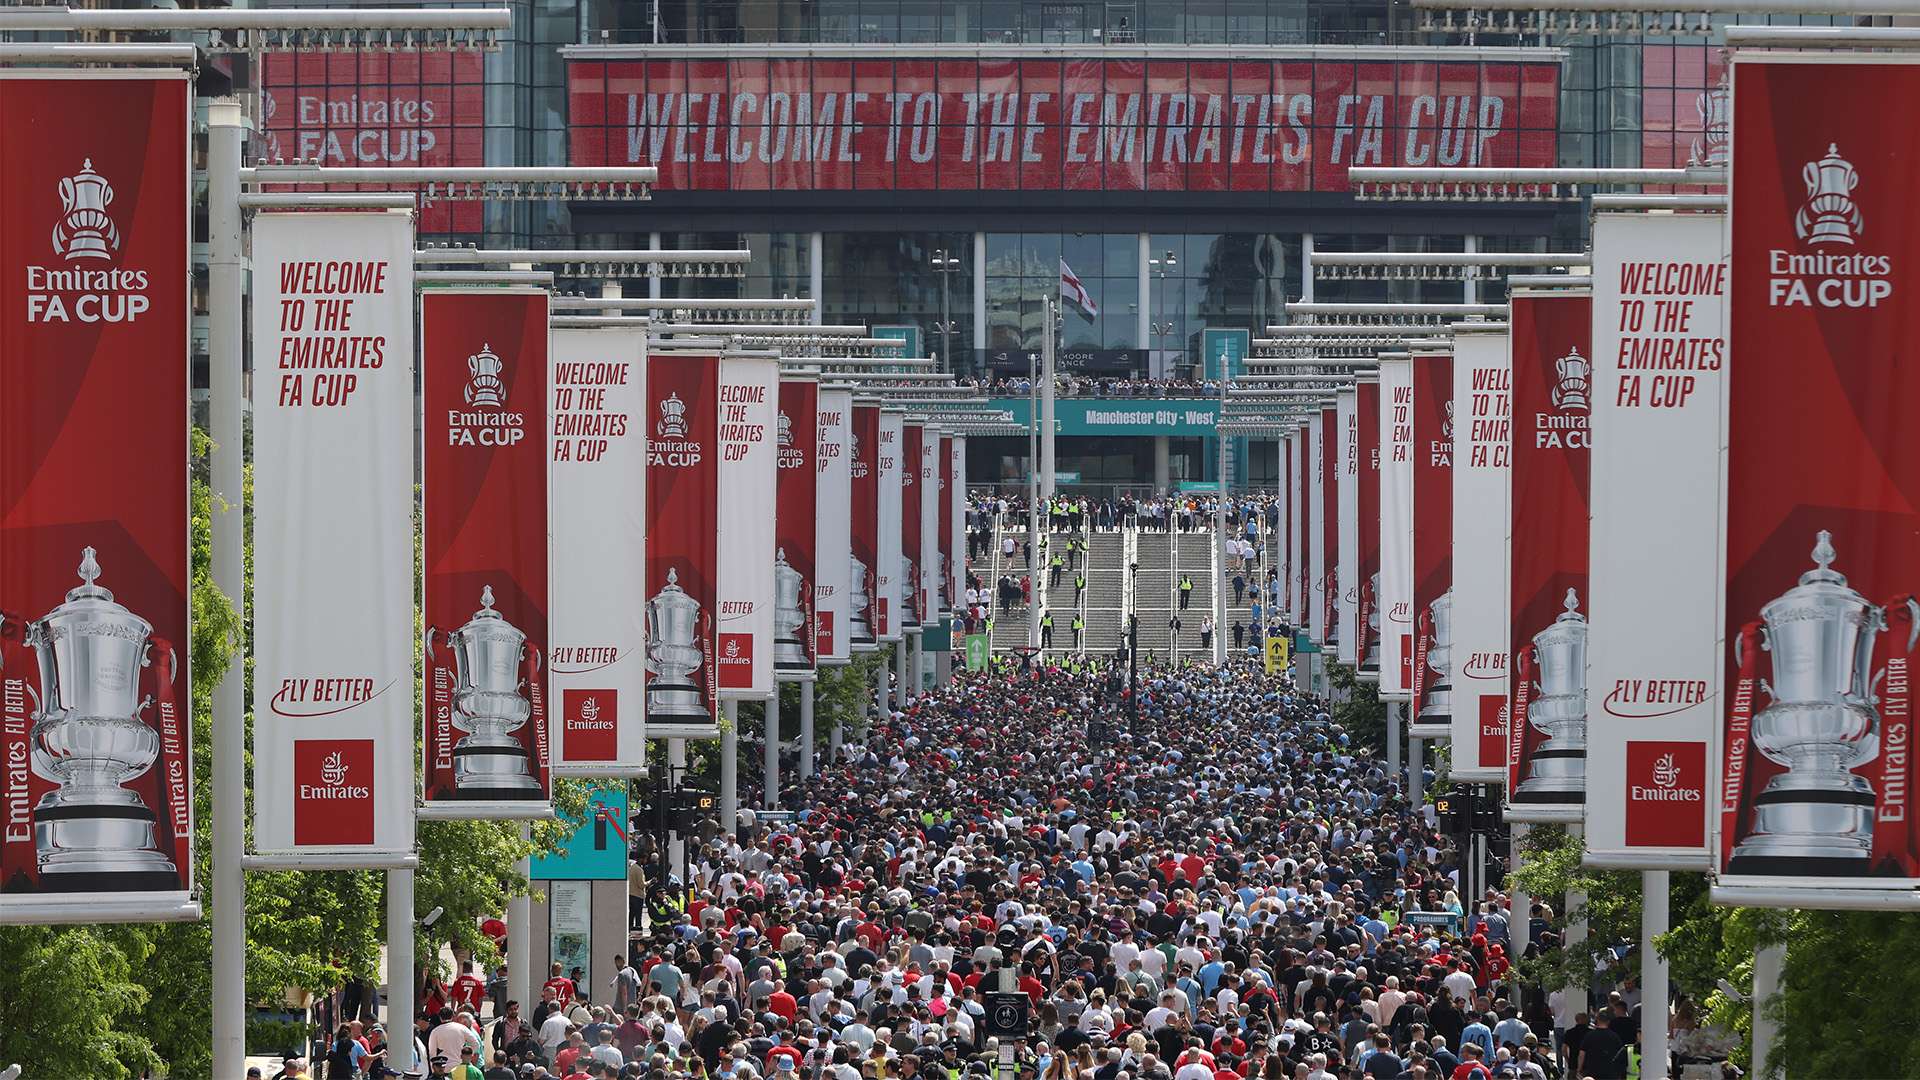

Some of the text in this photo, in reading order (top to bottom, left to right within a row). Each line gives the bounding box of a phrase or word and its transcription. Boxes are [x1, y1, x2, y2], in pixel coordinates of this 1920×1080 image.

[299, 94, 434, 124] Emirates
[627, 91, 1504, 166] WELCOME TO THE EMIRATES FA CUP
[300, 130, 436, 162] FA CUP
[1770, 250, 1890, 276] Emirates
[26, 265, 149, 291] Emirates
[279, 261, 388, 294] WELCOME
[1620, 262, 1726, 296] WELCOME
[1769, 279, 1892, 307] FA CUP
[27, 294, 150, 322] FA CUP
[279, 299, 352, 331] TO THE
[1619, 300, 1694, 333] TO THE
[278, 336, 386, 369] EMIRATES
[1617, 337, 1724, 371] EMIRATES
[555, 362, 629, 386] WELCOME
[278, 374, 358, 406] FA CUP
[555, 387, 606, 411] TO THE
[720, 384, 766, 403] ELCOME
[1616, 375, 1696, 408] FA CUP
[726, 404, 748, 422] THE
[1393, 406, 1407, 423] TO
[1472, 394, 1489, 417] TO
[448, 410, 524, 427] Emirates
[554, 413, 628, 438] EMIRATES
[1086, 410, 1154, 425] Manchester
[1156, 410, 1178, 426] City
[1186, 410, 1214, 425] West
[448, 428, 525, 446] FA CUP
[647, 439, 701, 452] Emirates
[1536, 432, 1564, 449] FA
[554, 439, 608, 463] FA CUP
[647, 454, 701, 467] FA CUP
[724, 444, 748, 461] CUP
[778, 458, 804, 468] CUP
[1393, 445, 1406, 462] FA
[1432, 454, 1450, 466] FA
[1471, 445, 1486, 468] FA
[722, 601, 754, 614] BETTER
[1394, 602, 1408, 616] FLY
[553, 646, 618, 664] FLY BETTER
[1470, 653, 1488, 669] FLY
[280, 677, 374, 703] FLY BETTER
[704, 664, 716, 701] Emirates
[1414, 661, 1426, 696] Emirates
[530, 682, 542, 706] BETTER
[1612, 679, 1706, 705] FLY BETTER
[435, 666, 452, 770] Emirates FLY BETTER
[567, 719, 614, 730] Emirates
[536, 719, 550, 768] Emirates
[1510, 719, 1524, 765] Emirates
[1722, 678, 1752, 813] Emirates FLY BETTER
[1879, 657, 1908, 822] Emirates FLY BETTER
[5, 679, 31, 844] Emirates FLY BETTER
[161, 702, 190, 838] Emirates FLY BETTER
[300, 783, 369, 801] Emirates
[700, 798, 712, 808] 02
[1631, 785, 1701, 803] Emirates
[1437, 801, 1448, 811] 02
[464, 986, 472, 1002] 7
[1311, 1038, 1320, 1050] B
